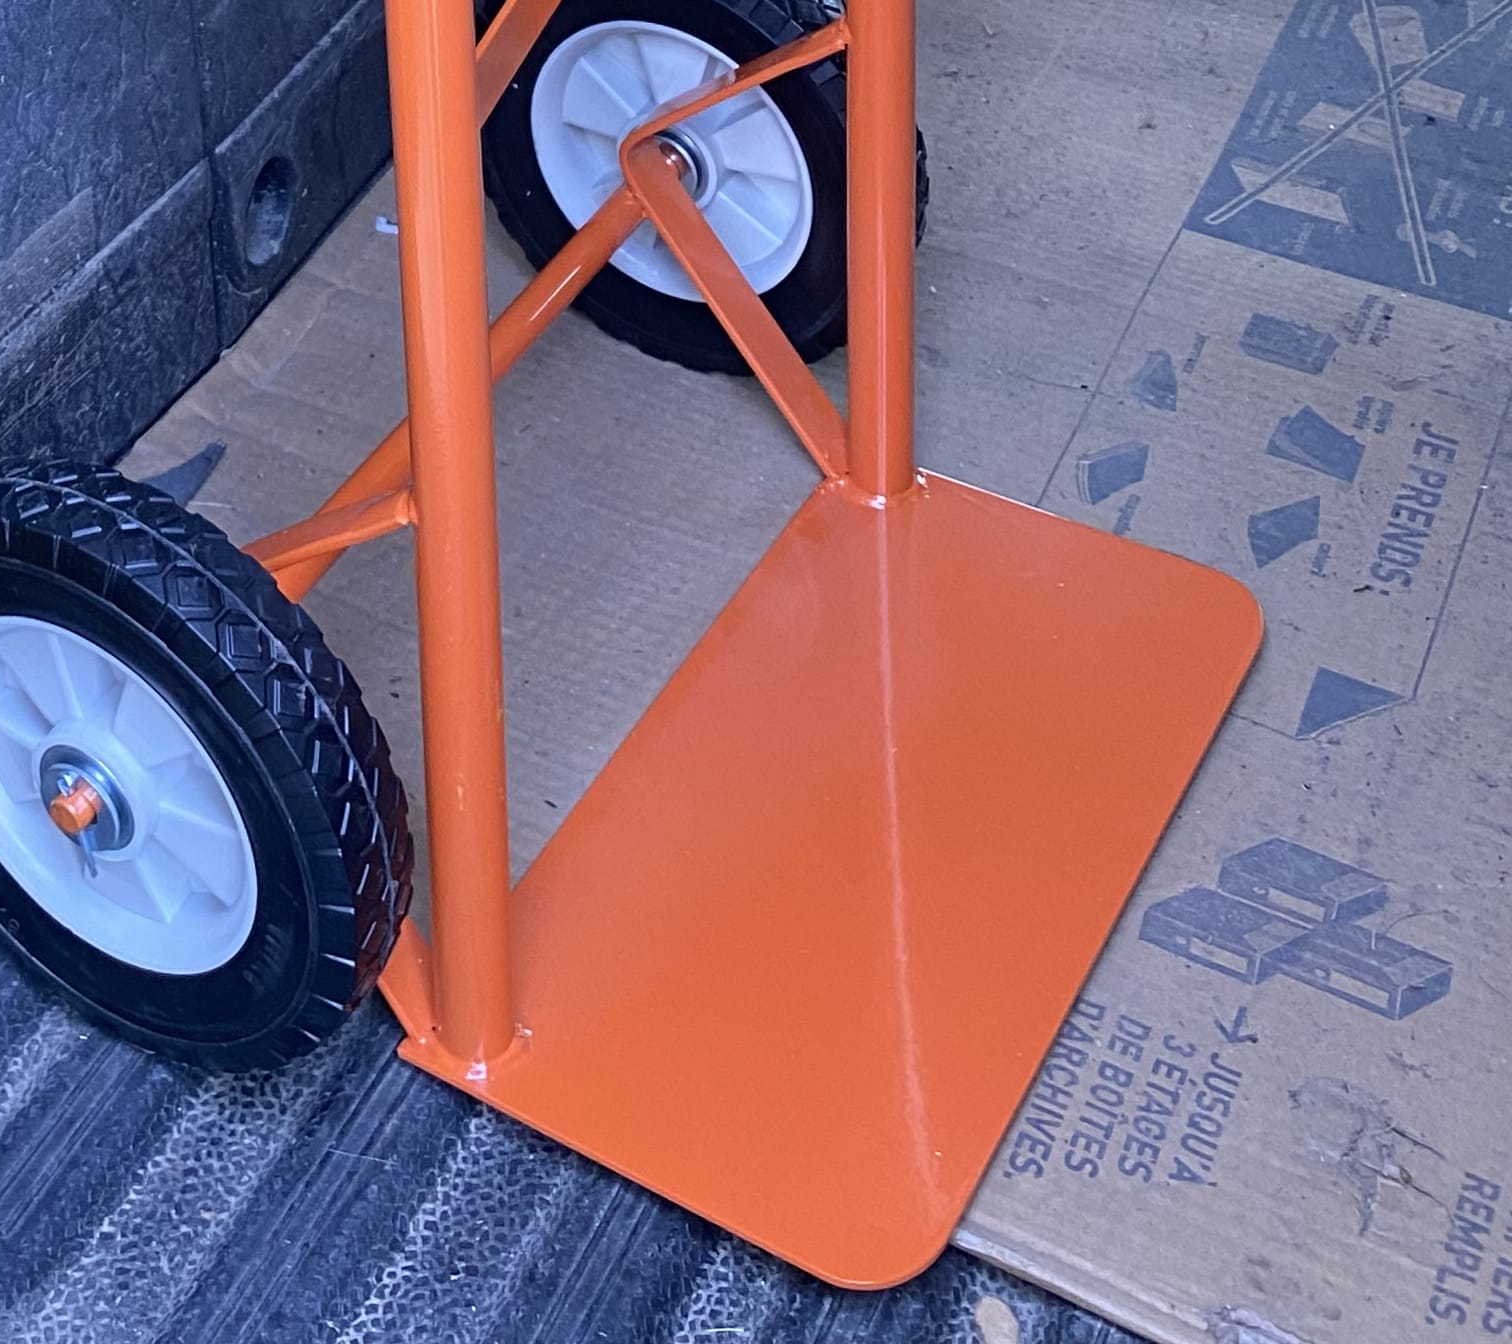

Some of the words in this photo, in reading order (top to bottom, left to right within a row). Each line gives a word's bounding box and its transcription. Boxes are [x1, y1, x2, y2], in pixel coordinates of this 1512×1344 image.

[1412, 421, 1460, 464] JE
[1002, 999, 1106, 1180] D'ARCHIVES.
[1107, 1014, 1153, 1062] DE
[1162, 1033, 1197, 1059] 3
[1064, 1060, 1139, 1179] BOÎTES
[1117, 1058, 1198, 1184] ÉTAGES
[1424, 1170, 1502, 1326] REMPLIS.
